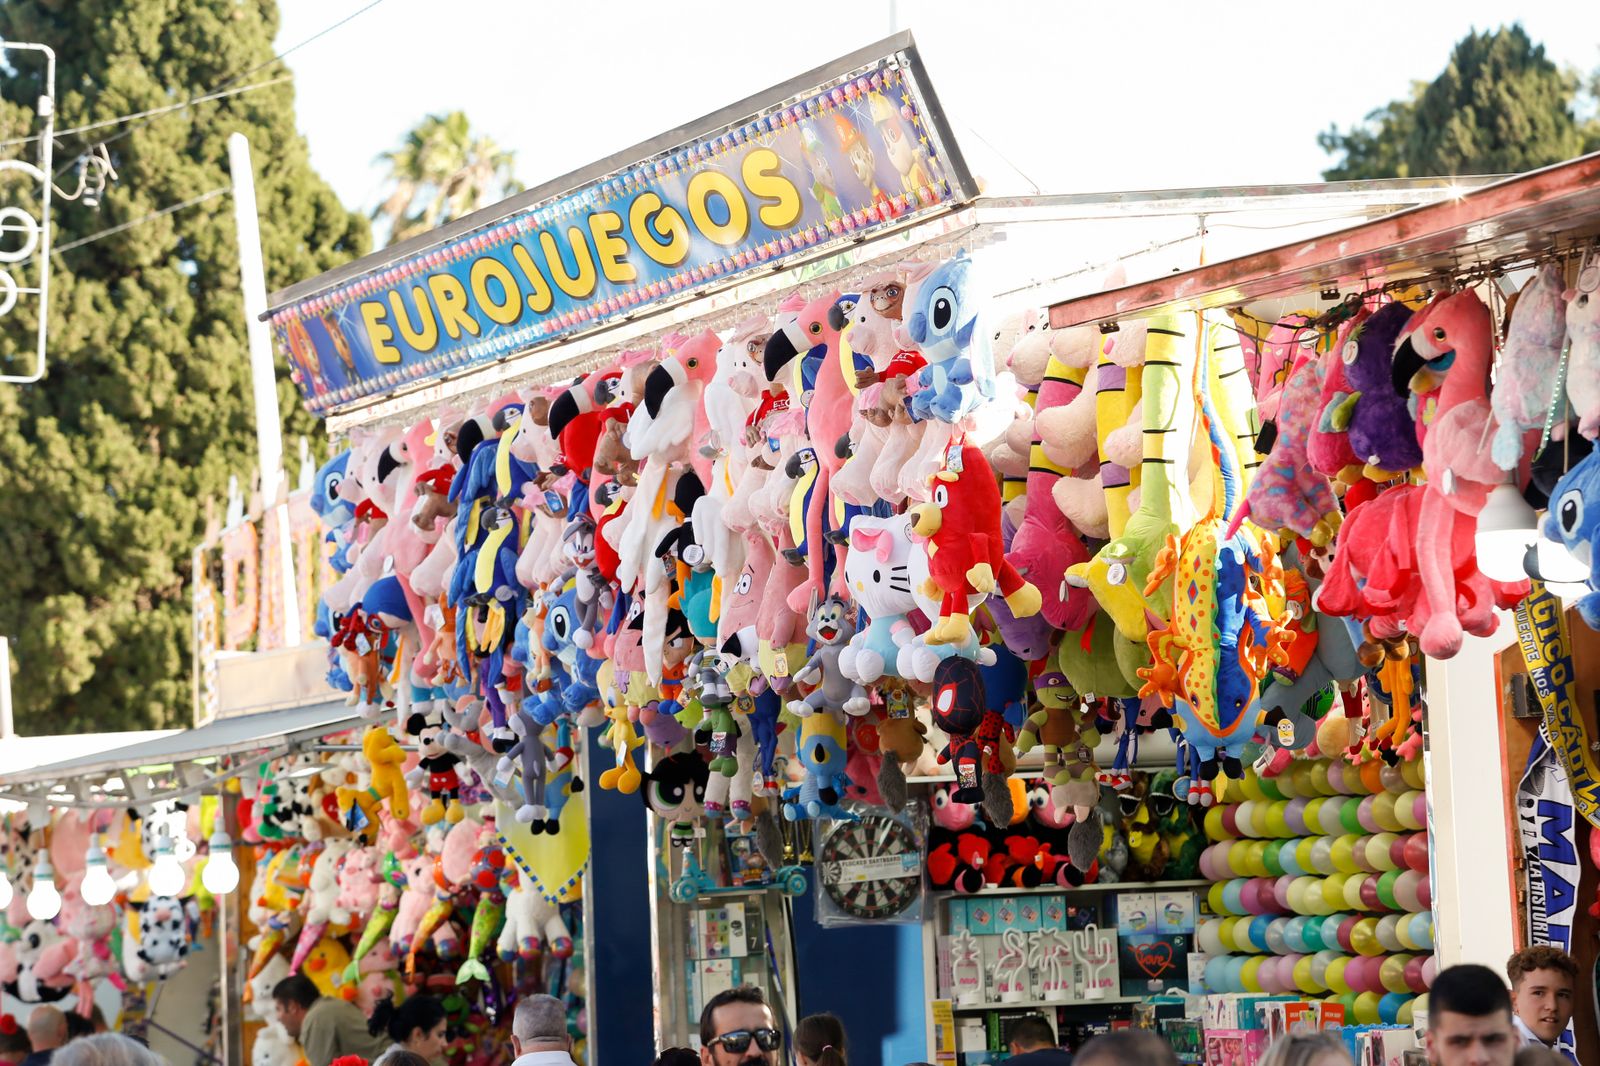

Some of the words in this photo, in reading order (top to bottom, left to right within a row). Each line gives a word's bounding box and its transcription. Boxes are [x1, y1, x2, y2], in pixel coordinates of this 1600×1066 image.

[359, 148, 804, 366] EUROJUEGOS
[1531, 667, 1550, 698] NOS
[1546, 703, 1556, 725] VA
[1551, 730, 1560, 741] A
